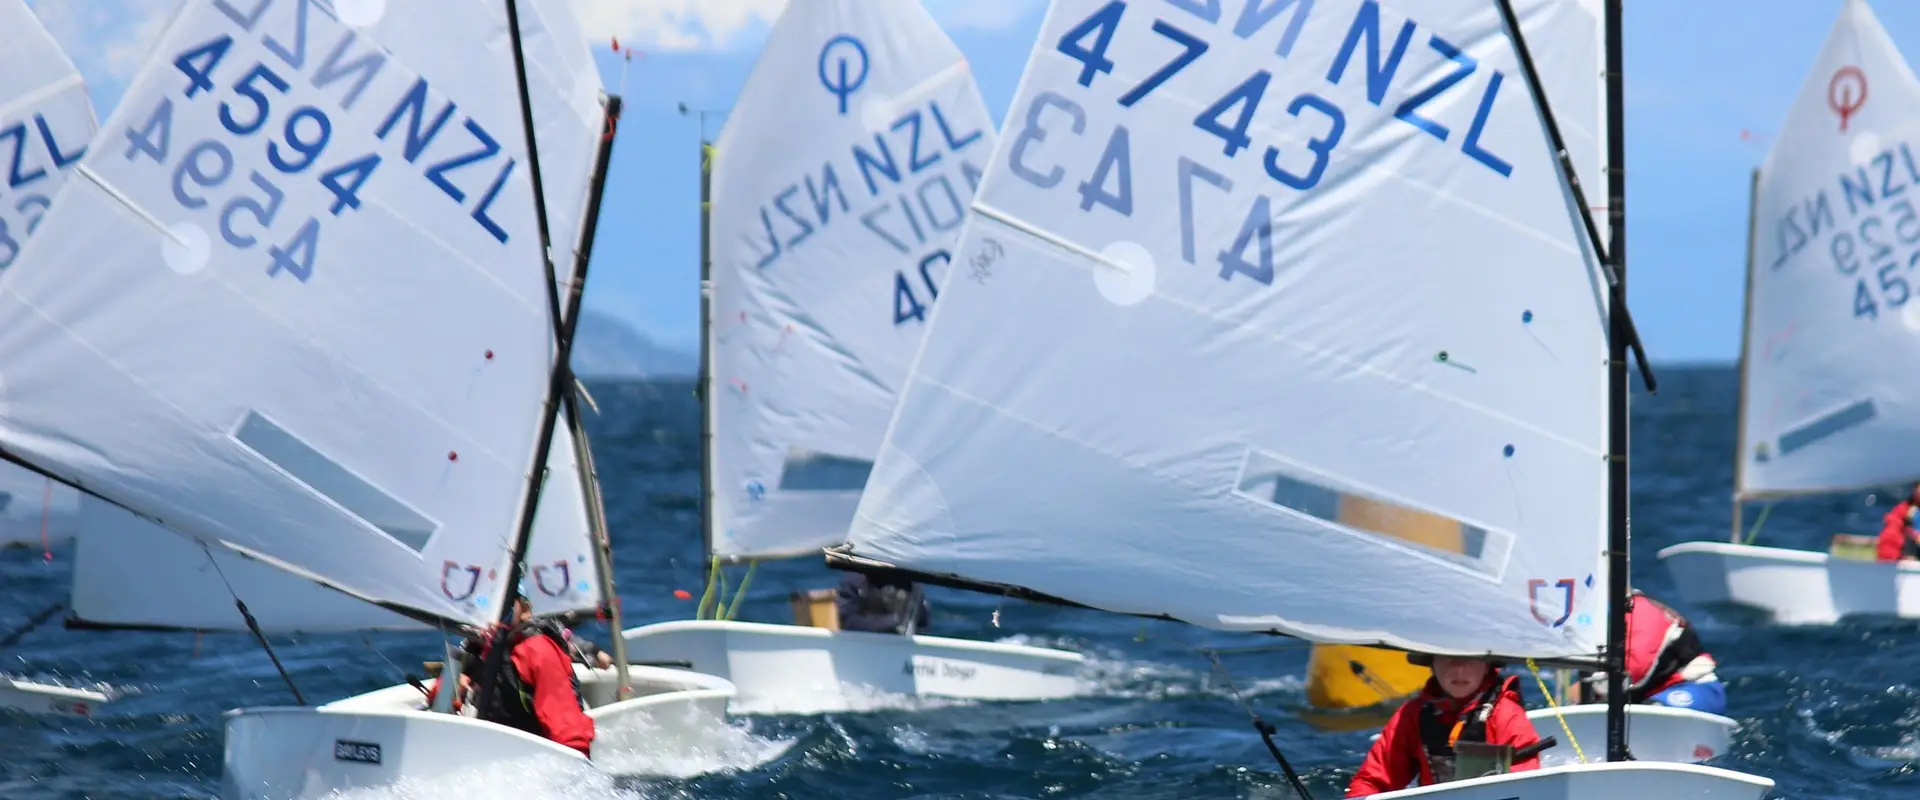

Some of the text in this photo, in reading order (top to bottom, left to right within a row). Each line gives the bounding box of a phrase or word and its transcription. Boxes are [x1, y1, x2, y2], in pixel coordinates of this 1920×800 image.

[173, 33, 382, 217] 4594
[375, 76, 516, 245] NZL
[851, 101, 982, 196] NZL
[1057, 0, 1347, 191] 4743
[1326, 0, 1514, 178] NZL
